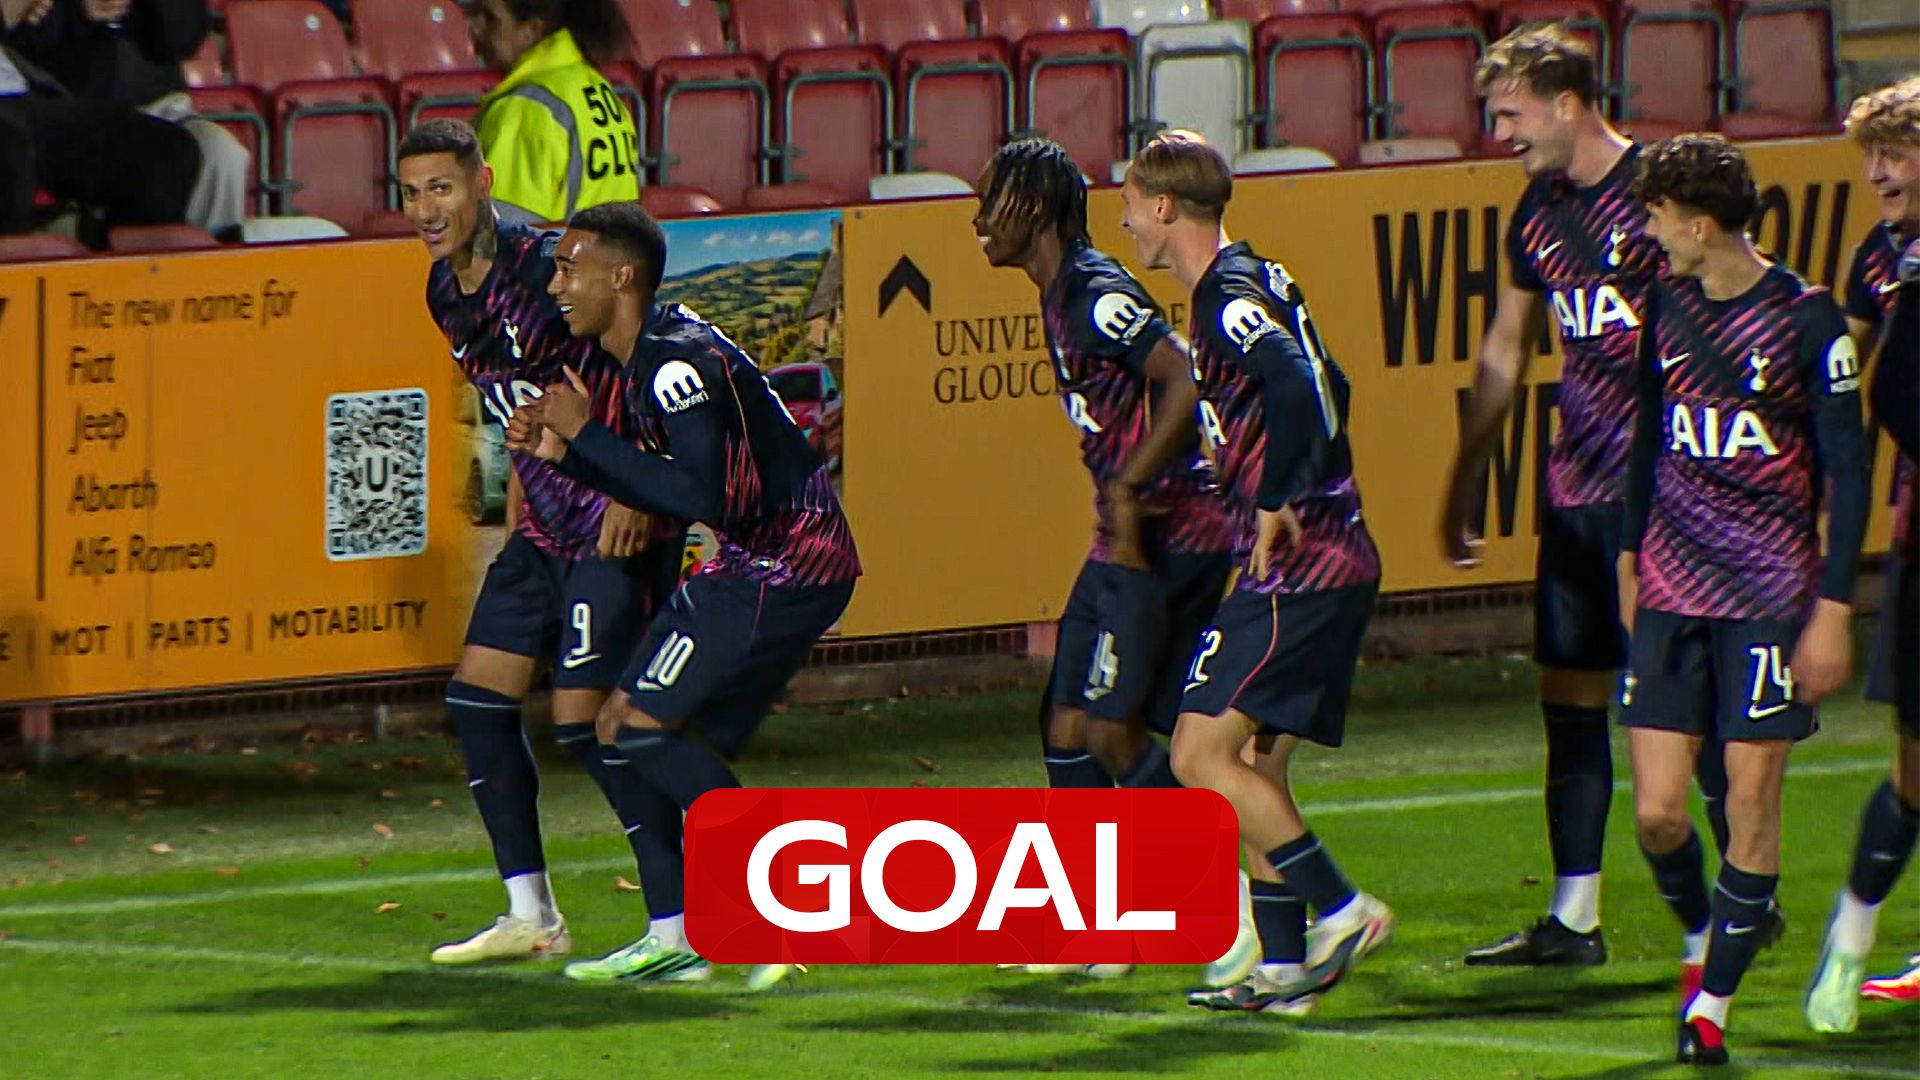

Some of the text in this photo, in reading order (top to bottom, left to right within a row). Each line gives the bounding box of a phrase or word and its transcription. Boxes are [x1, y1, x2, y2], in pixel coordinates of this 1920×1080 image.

[67, 277, 298, 329] The new name for
[1373, 206, 1553, 367] WH
[1551, 284, 1642, 338] AIA
[934, 313, 1048, 356] UNIVE
[67, 346, 115, 385] Fiat
[933, 359, 1056, 405] GLOUC
[67, 403, 129, 456] Jeep
[1668, 402, 1781, 459] AIA
[67, 469, 158, 515] Abarth
[366, 456, 389, 493] U
[68, 533, 216, 579] Alfa Romeo
[50, 624, 111, 657] MOT
[148, 615, 231, 649] PARTS
[268, 600, 428, 641] MOTABILITY
[571, 602, 592, 656] 9
[1750, 645, 1794, 702] 74
